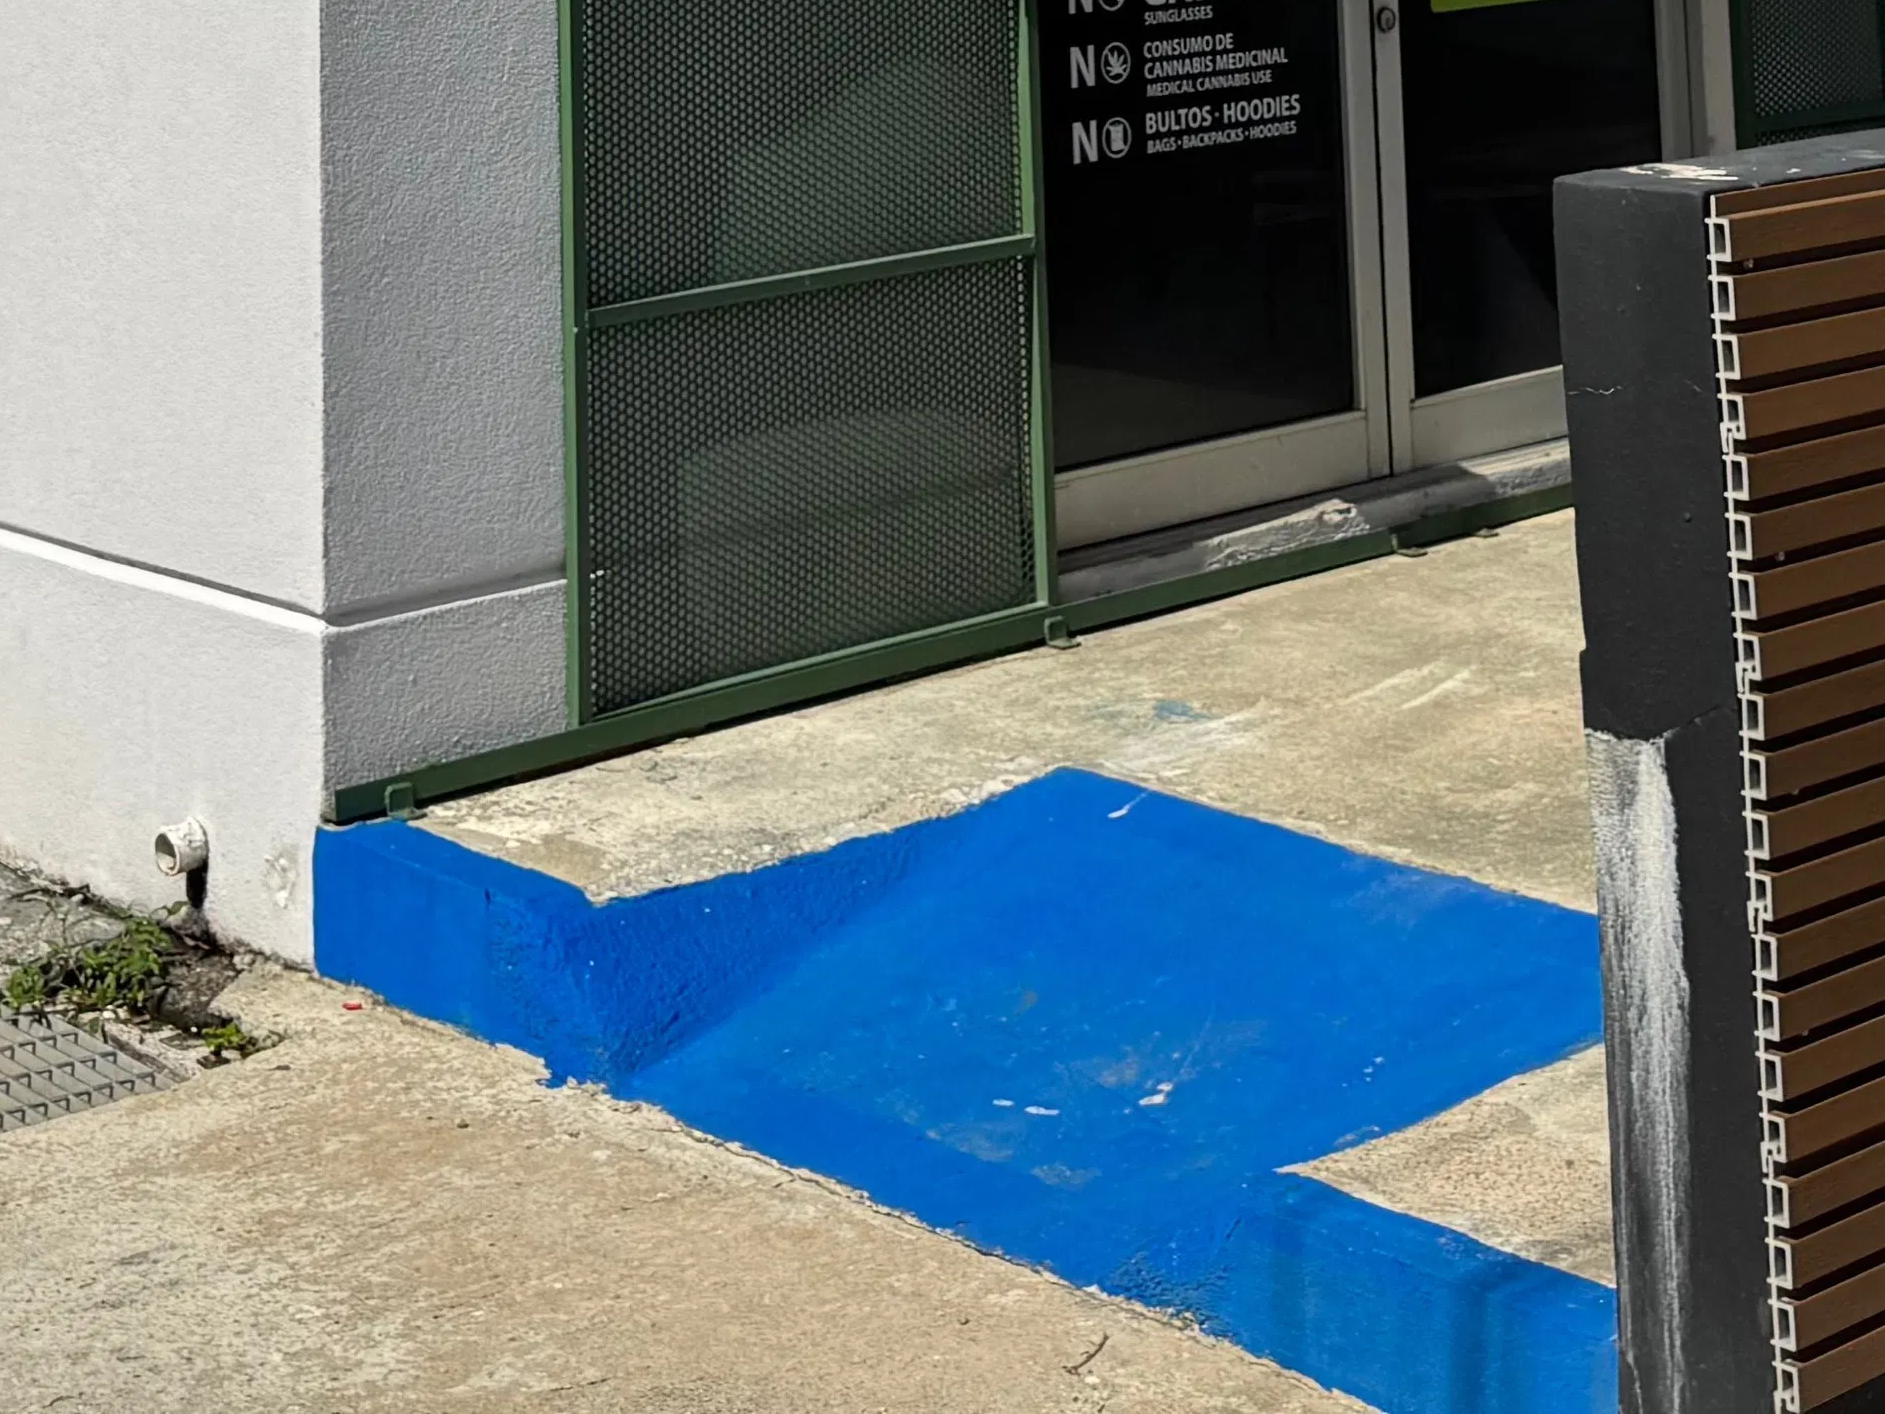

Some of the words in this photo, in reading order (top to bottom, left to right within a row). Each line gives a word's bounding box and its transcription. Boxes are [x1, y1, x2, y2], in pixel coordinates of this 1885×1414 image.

[1144, 6, 1214, 25] SUNGLASSES
[1143, 35, 1213, 58] CONSUMO
[1215, 33, 1234, 50] DE
[1144, 56, 1213, 79] CANNABIS
[1215, 47, 1288, 72] MEDICINAL
[1146, 79, 1195, 98] MEDICAL
[1197, 72, 1250, 93] CANNABIS
[1252, 69, 1273, 85] USE
[1145, 105, 1212, 135] BULTOS
[1223, 93, 1301, 125] HOODIES
